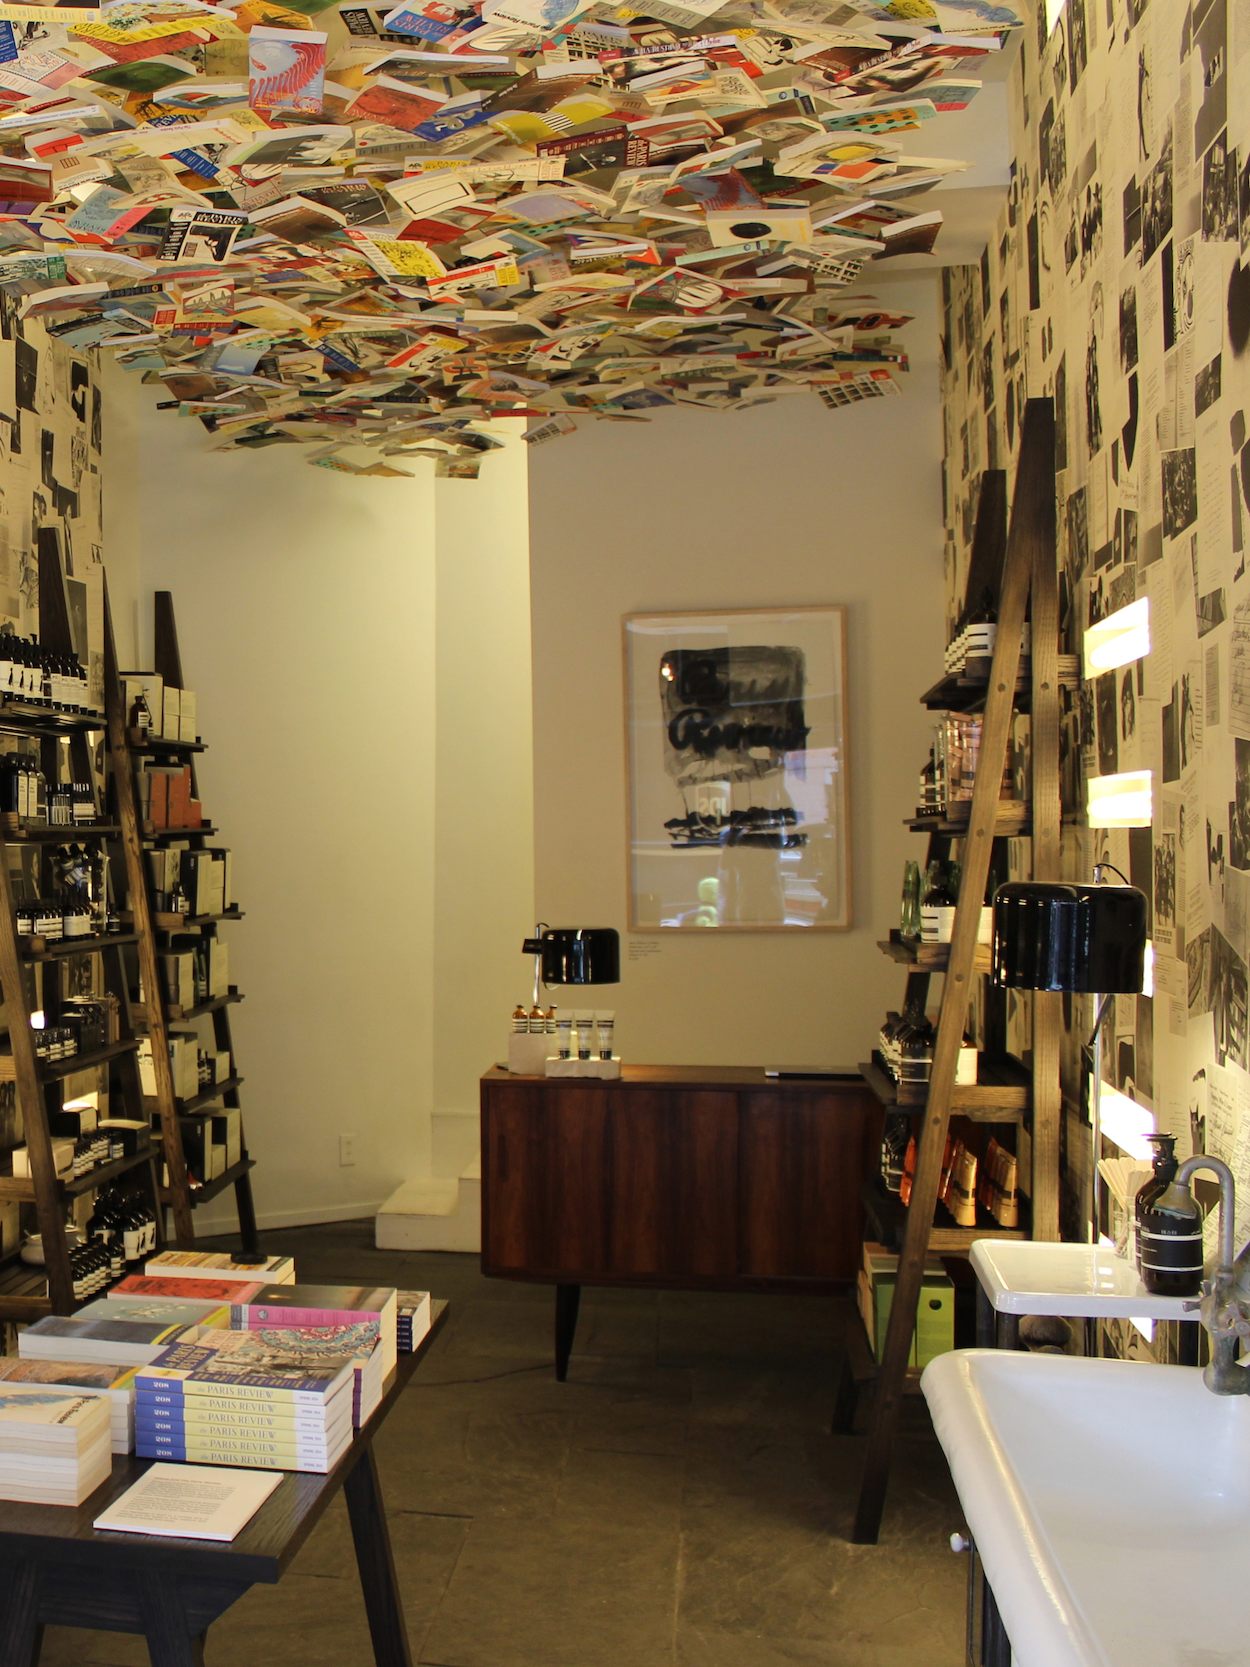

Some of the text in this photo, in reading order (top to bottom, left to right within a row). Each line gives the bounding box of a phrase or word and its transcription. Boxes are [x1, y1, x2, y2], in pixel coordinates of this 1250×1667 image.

[394, 19, 432, 36] PARIS
[400, 14, 450, 34] REVIEW
[492, 12, 540, 29] Paris Review
[627, 140, 636, 167] REVIEW
[636, 146, 648, 167] PARIS
[170, 1344, 196, 1366] PARIS
[176, 1350, 211, 1370] REVIEW
[207, 1386, 235, 1396] PARIS
[239, 1388, 274, 1399] REVIEW
[209, 1400, 237, 1409] PARIS
[240, 1403, 276, 1413] REVIEW
[208, 1413, 236, 1423] PARIS
[240, 1416, 275, 1426] REVIEW
[210, 1426, 237, 1436] PARIS
[240, 1429, 276, 1439] REVIEW
[210, 1440, 238, 1449] PARIS
[241, 1442, 277, 1452] REVIEW
[211, 1453, 239, 1463] PARIS
[242, 1456, 278, 1466] REVIEW
